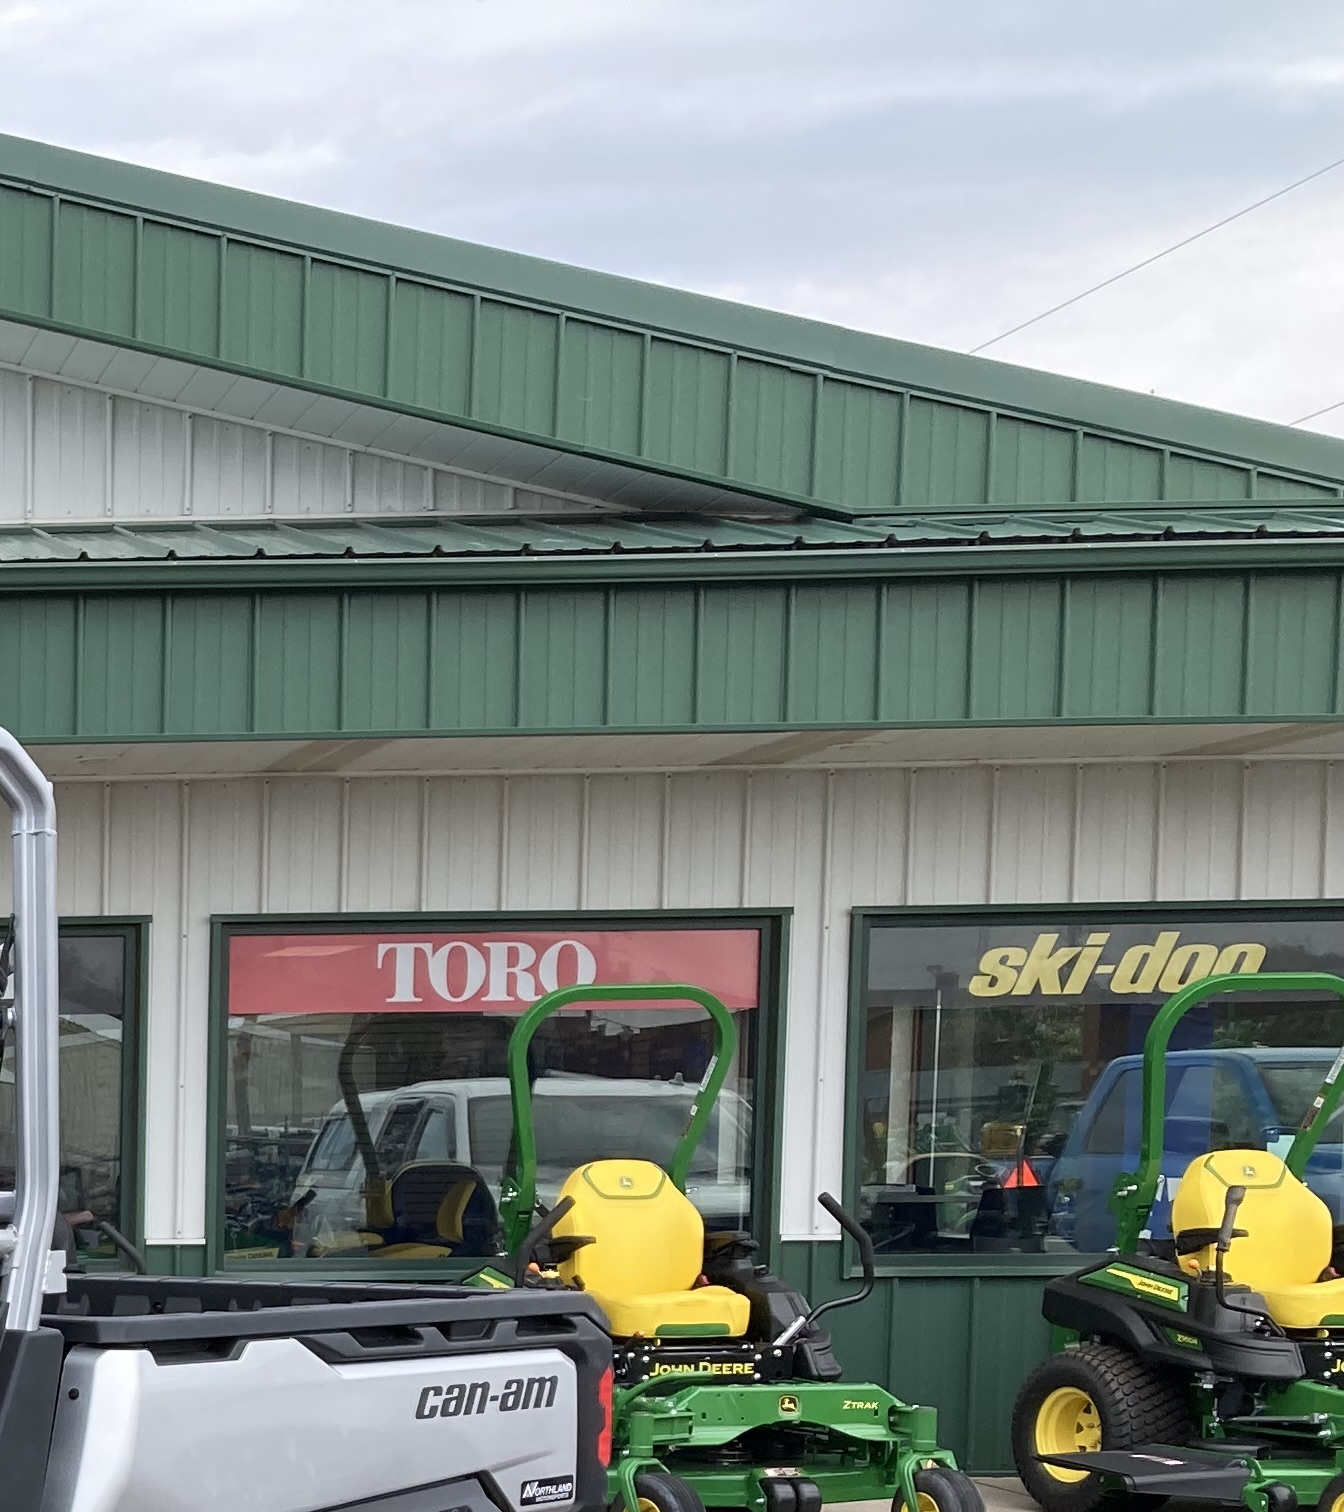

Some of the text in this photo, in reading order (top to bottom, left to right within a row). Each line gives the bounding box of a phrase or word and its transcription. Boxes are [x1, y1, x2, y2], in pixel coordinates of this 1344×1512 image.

[376, 940, 597, 1002] TORO
[968, 931, 1268, 997] ski-doo
[649, 1361, 755, 1376] JOHN DEERE
[414, 1375, 559, 1420] can-am
